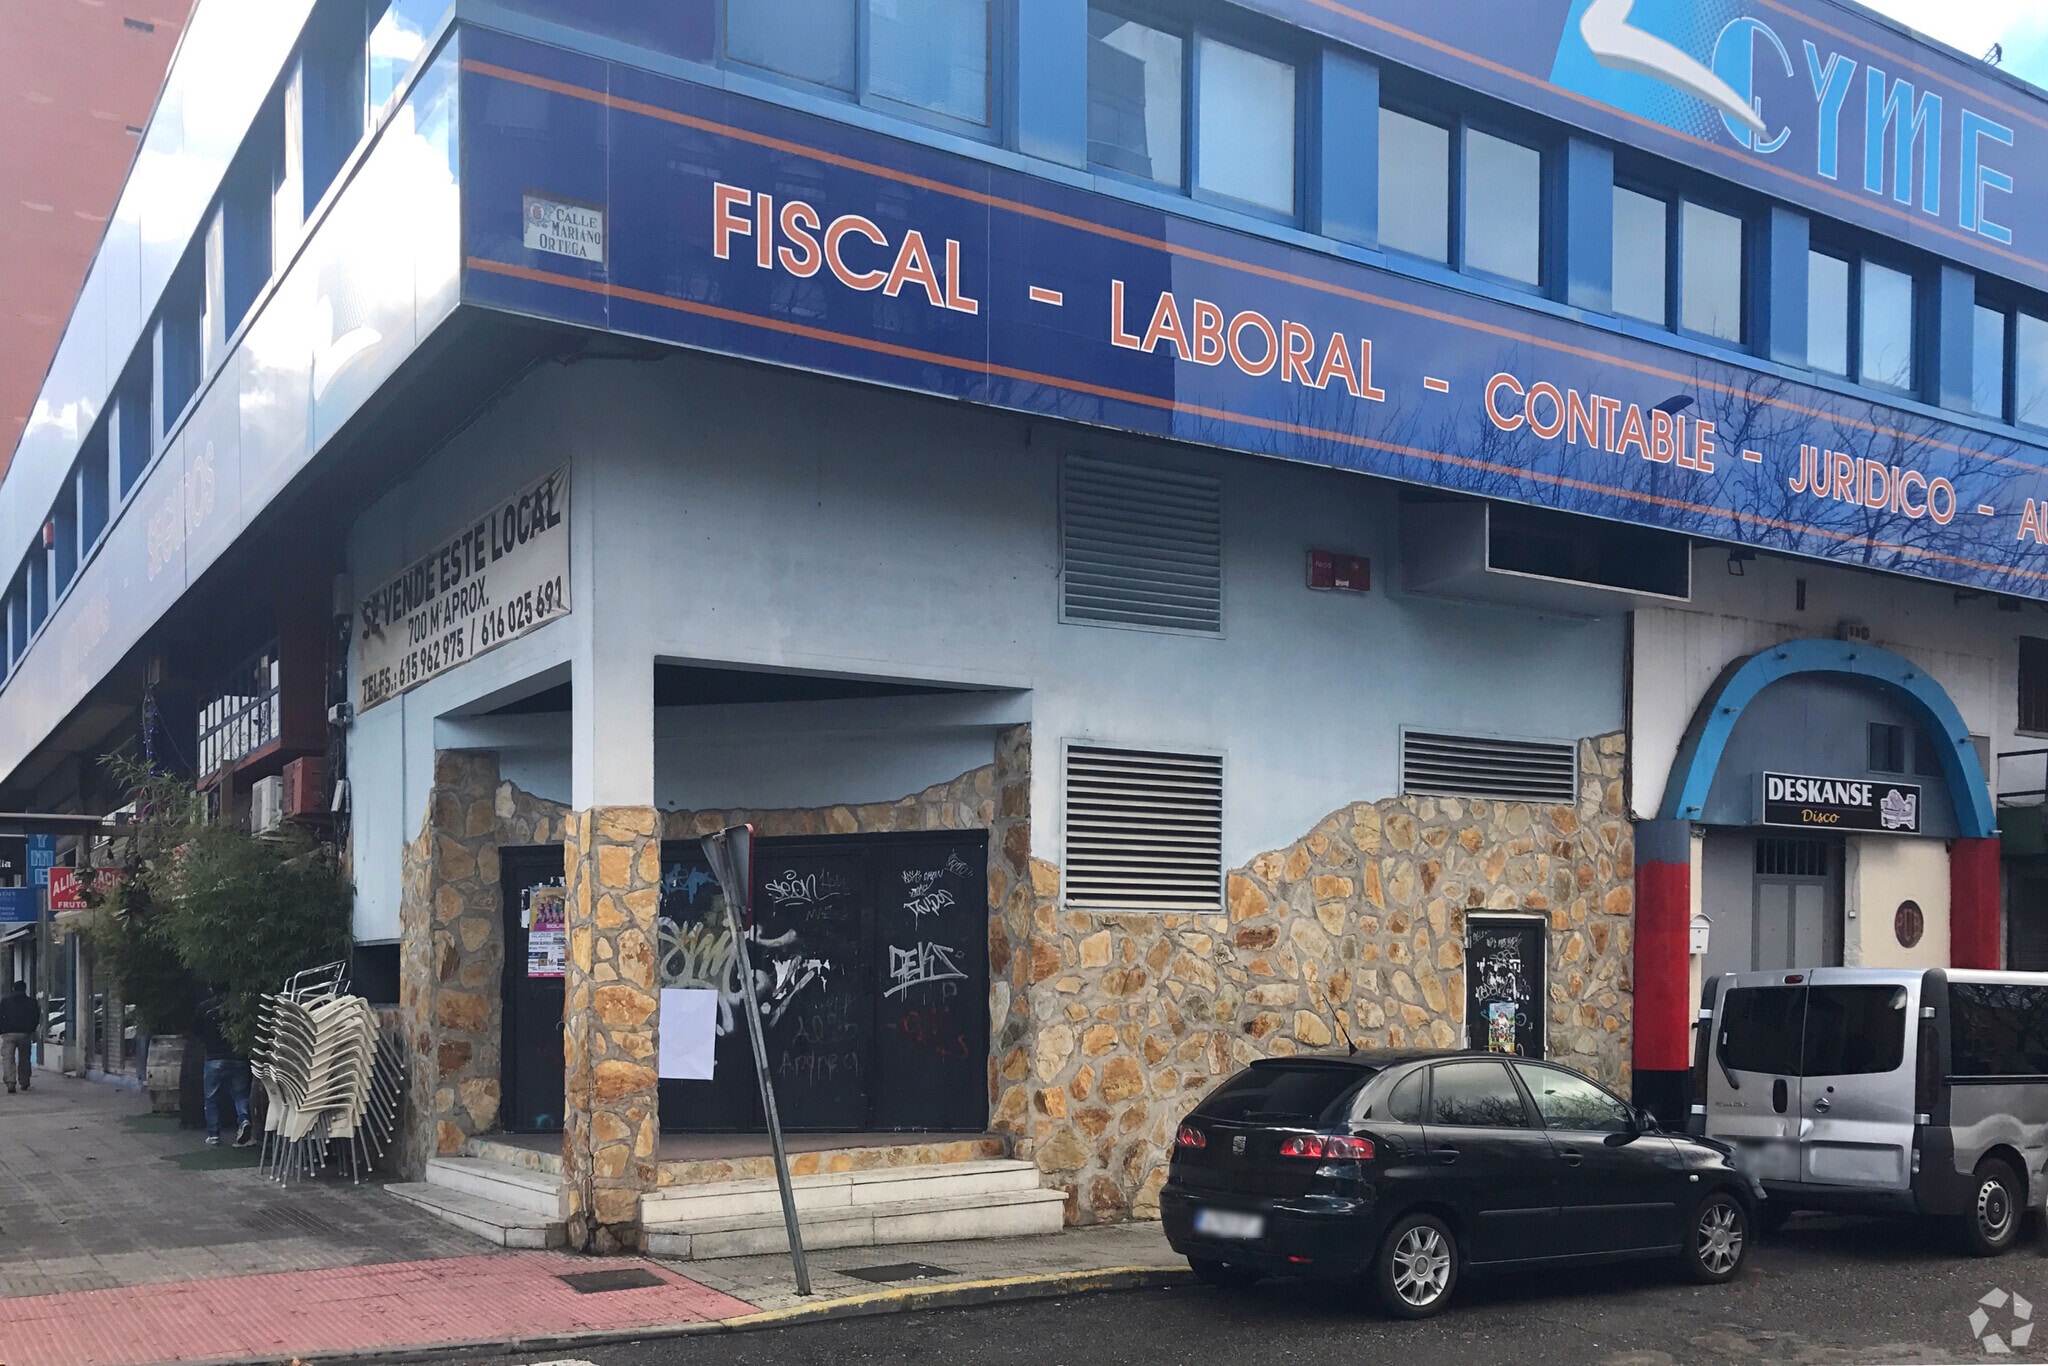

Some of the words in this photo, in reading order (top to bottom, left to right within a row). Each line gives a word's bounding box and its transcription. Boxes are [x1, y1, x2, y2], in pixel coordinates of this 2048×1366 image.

[1711, 17, 2014, 245] CYME
[552, 220, 601, 245] MARIANO
[556, 208, 597, 229] CALLE
[540, 233, 587, 257] ORTEGA
[714, 182, 979, 315] FISCAL
[1111, 279, 1385, 402] LABORAL
[1485, 372, 1715, 473] CONTABLE
[1789, 444, 1957, 525] JURIDICO
[360, 595, 380, 639] SE
[383, 556, 436, 626] VENDE
[440, 523, 486, 594] ESTE
[491, 476, 561, 562] LOCAL
[400, 651, 418, 686] 615
[420, 640, 440, 676] 962
[443, 627, 464, 665] 975
[481, 606, 505, 646] 616
[508, 590, 532, 633] 025
[536, 575, 562, 618] 691
[408, 610, 427, 648] 700
[443, 575, 489, 628] APROX.
[1768, 777, 1872, 807] DESKANSE
[1801, 809, 1840, 823] Disco
